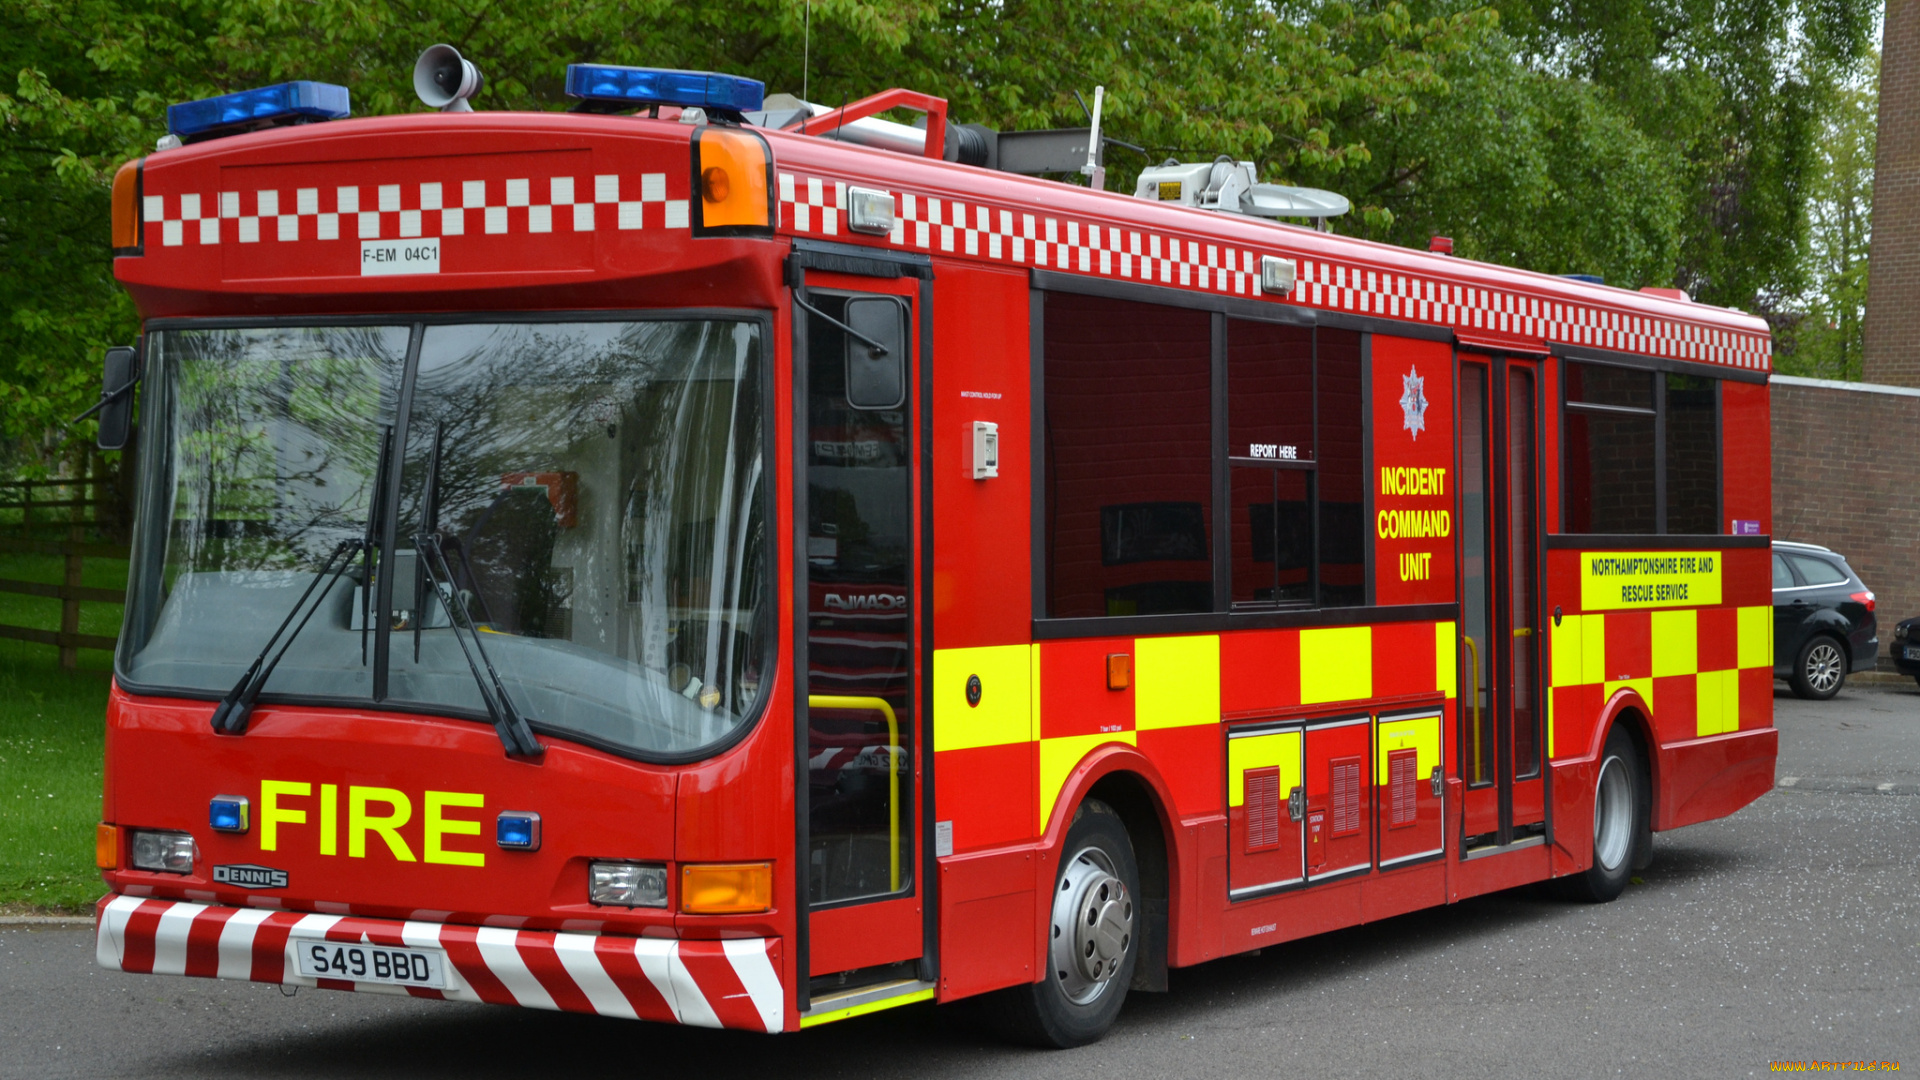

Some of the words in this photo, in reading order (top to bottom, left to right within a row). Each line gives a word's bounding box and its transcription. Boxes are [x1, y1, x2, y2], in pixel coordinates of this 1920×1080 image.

[362, 248, 397, 263] F-EM
[404, 246, 438, 262] 04C1
[1250, 443, 1277, 459] REPORT
[1279, 445, 1297, 460] HERE
[1381, 466, 1446, 496] INCIDENT
[1377, 510, 1451, 539] COMMAND
[1399, 552, 1432, 582] UNIT
[1591, 558, 1678, 576] NORTHAMPTONSHIRE
[1680, 557, 1696, 574] FIRE
[1698, 557, 1714, 574] AND
[1621, 585, 1654, 603] RESCUE
[1656, 583, 1689, 601] SERVICE
[260, 779, 486, 868] FIRE
[214, 865, 288, 887] DENNIS
[311, 945, 367, 976] S49
[372, 950, 430, 982] BBD
